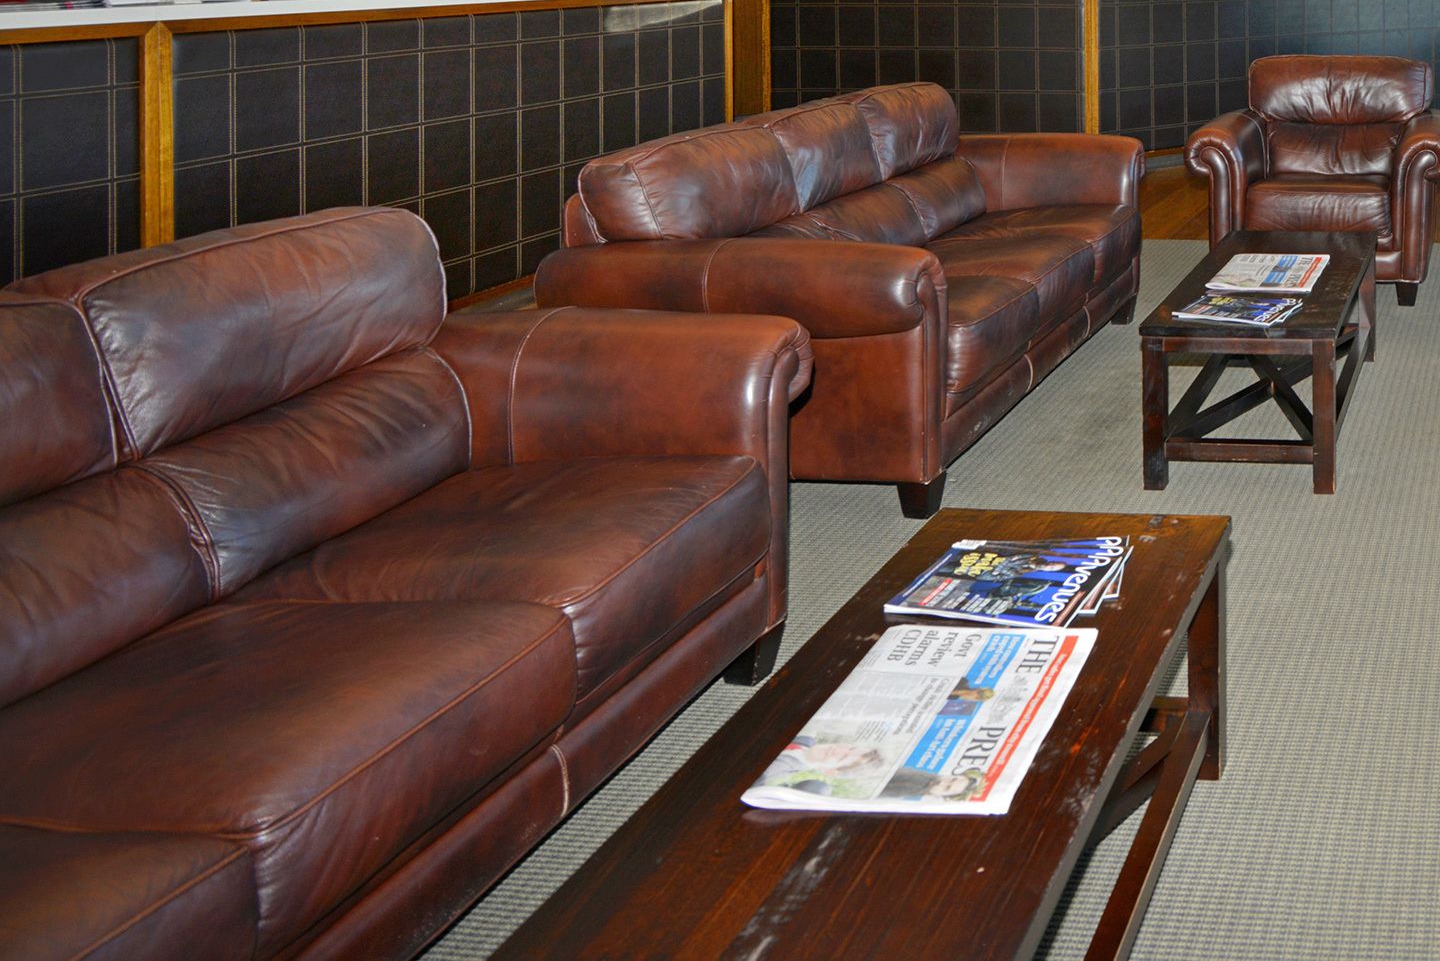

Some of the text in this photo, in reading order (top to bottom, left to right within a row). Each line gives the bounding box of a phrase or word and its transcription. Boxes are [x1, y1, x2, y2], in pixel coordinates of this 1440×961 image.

[887, 629, 922, 661] CDHB
[905, 630, 940, 665] alarms
[928, 632, 959, 667] review
[954, 633, 982, 657] Govt
[952, 636, 1059, 775] THE PRES
